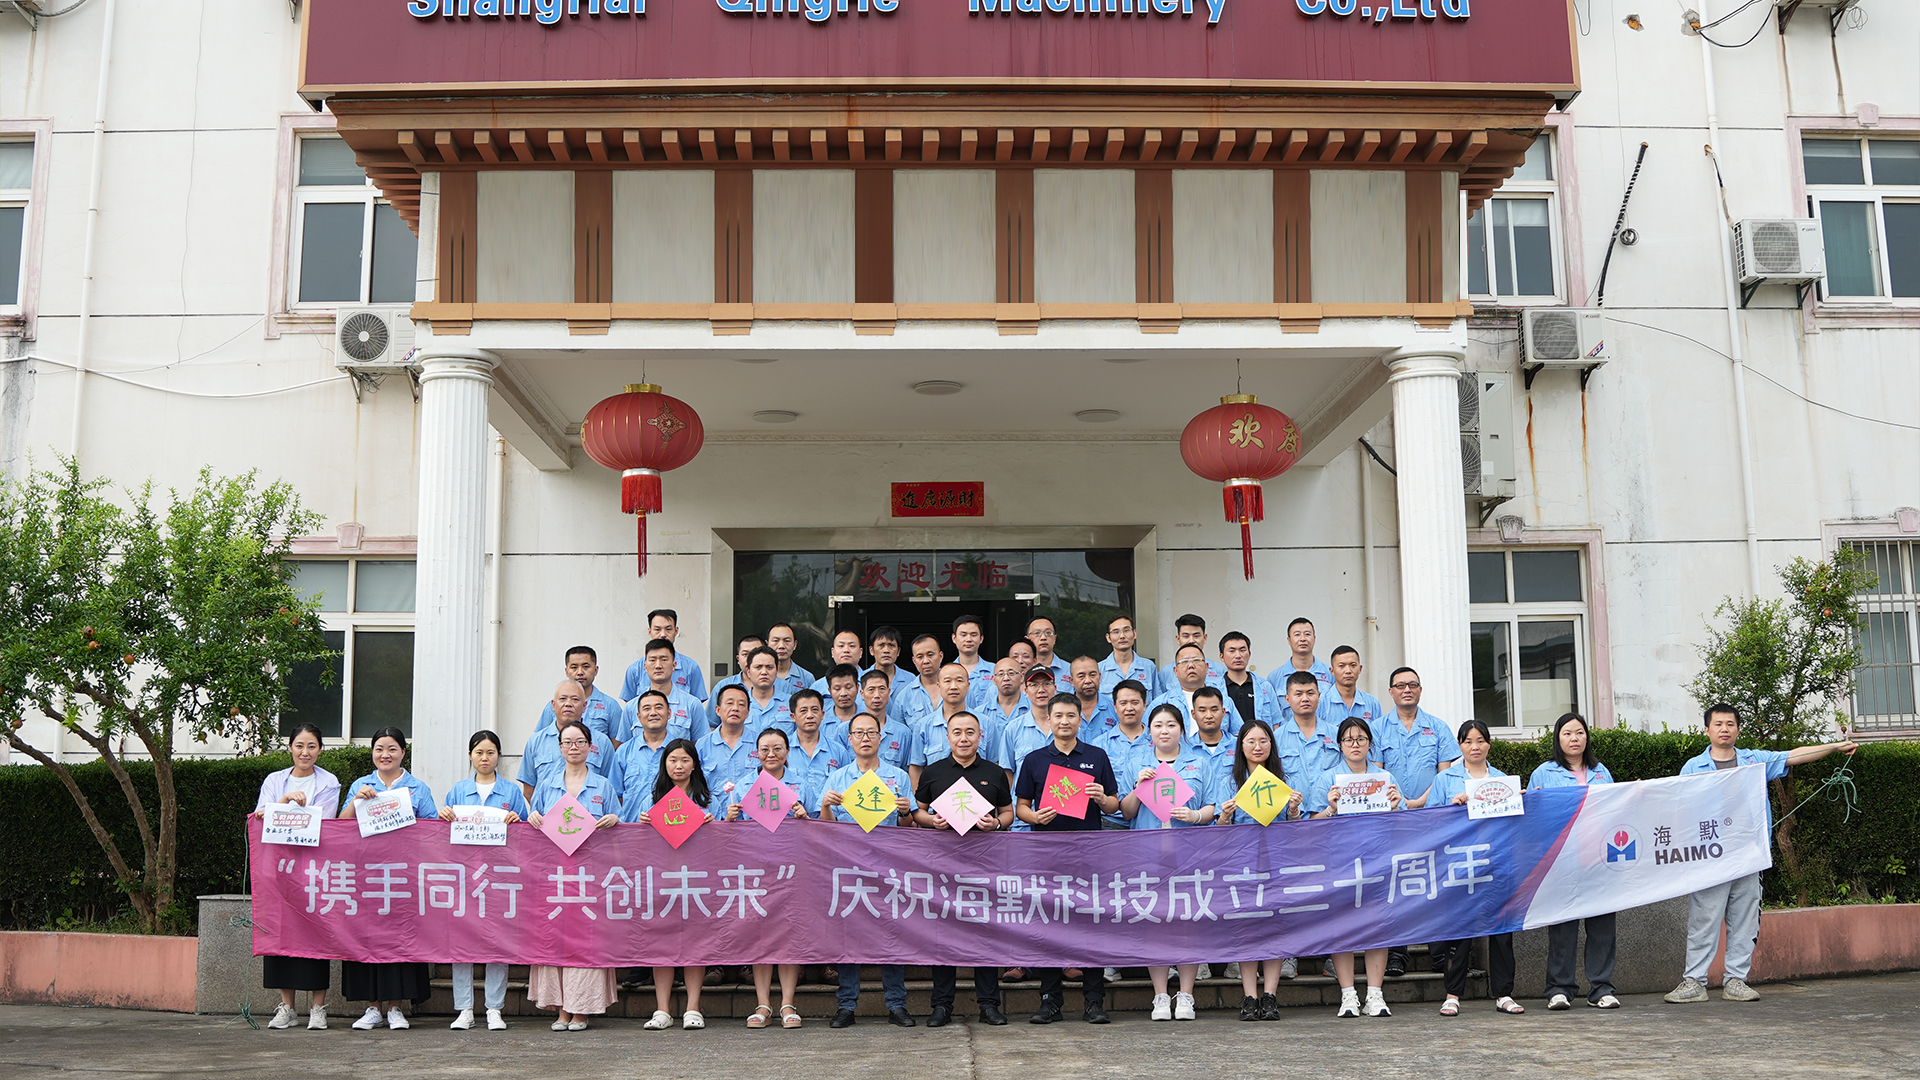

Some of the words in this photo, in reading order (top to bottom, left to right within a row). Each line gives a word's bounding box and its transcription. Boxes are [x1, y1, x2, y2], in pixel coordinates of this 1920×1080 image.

[859, 561, 1009, 590] 欢迎光临
[756, 787, 780, 811] 相
[855, 786, 887, 812] 逢
[1153, 778, 1176, 804] 同
[1250, 780, 1277, 808] 行
[1653, 819, 1719, 847] 海默
[1655, 842, 1724, 866] HAIMO
[828, 843, 1494, 925] 庆祝海默科技成立三十周年
